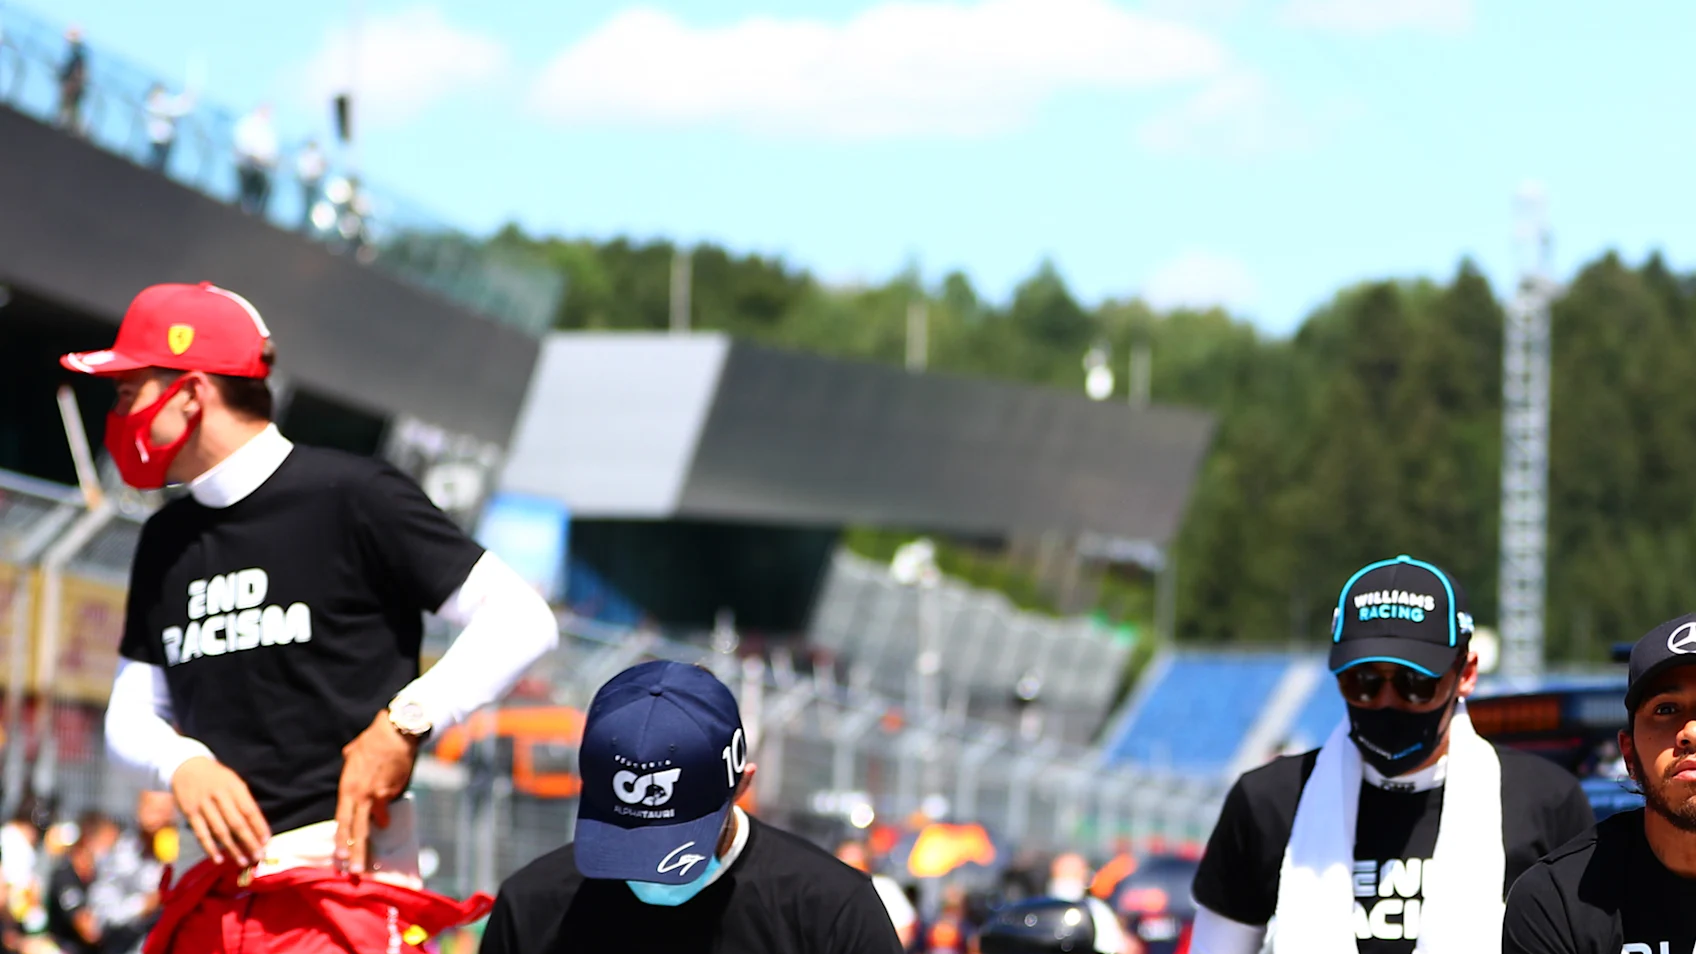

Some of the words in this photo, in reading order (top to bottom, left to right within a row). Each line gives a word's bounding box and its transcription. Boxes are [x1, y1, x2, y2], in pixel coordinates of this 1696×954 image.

[187, 567, 268, 620] END
[1354, 589, 1435, 611] WILLIAMS
[1358, 605, 1425, 622] RACING
[162, 602, 312, 667] RACISM
[722, 728, 747, 788] 10
[1354, 859, 1423, 898] EN
[1353, 899, 1422, 940] ACI
